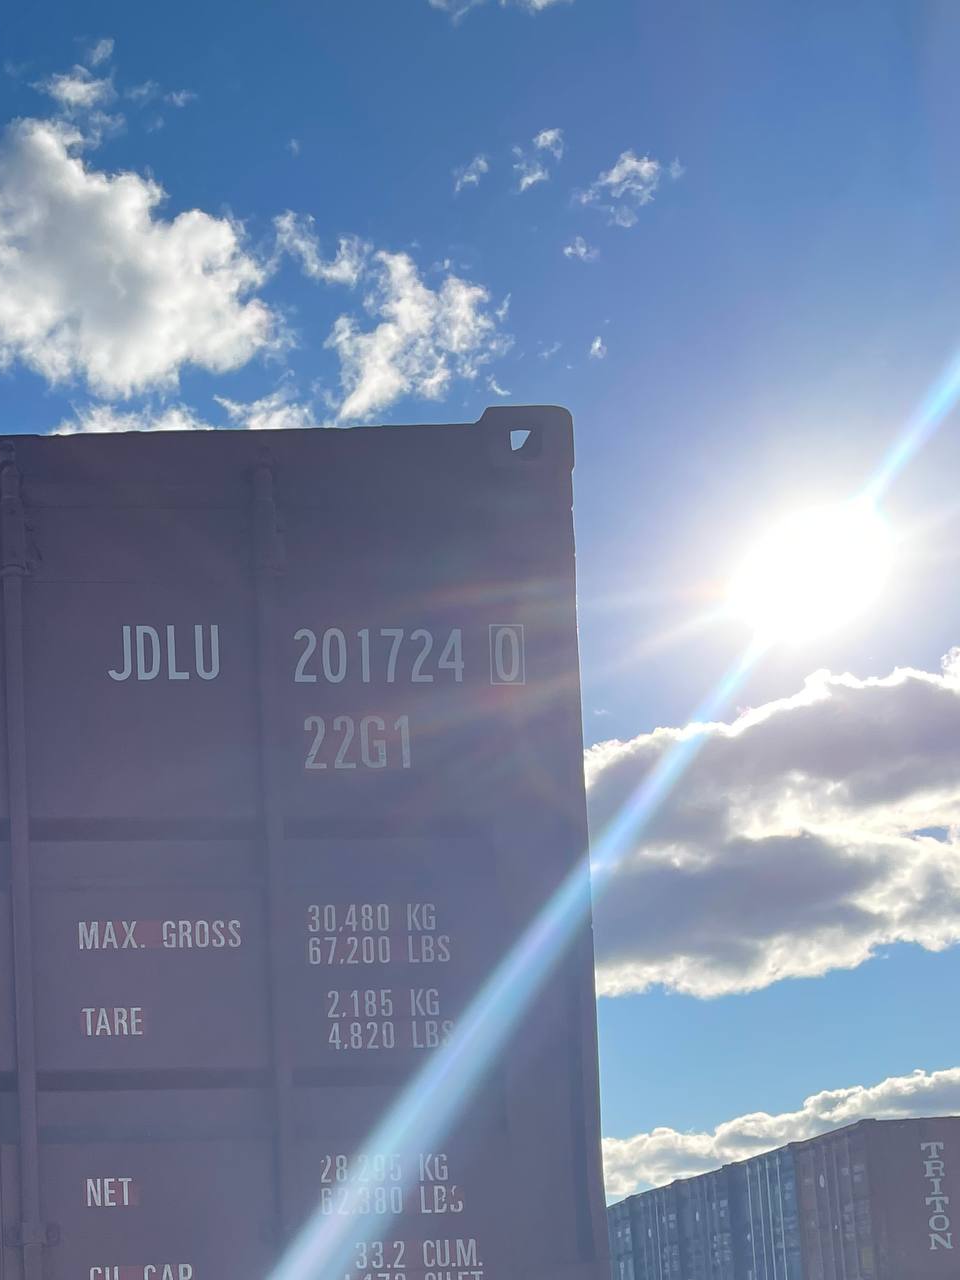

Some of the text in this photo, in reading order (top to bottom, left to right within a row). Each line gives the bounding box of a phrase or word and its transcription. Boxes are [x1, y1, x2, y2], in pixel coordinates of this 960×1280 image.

[108, 624, 522, 684] JDLU 201724 0
[303, 715, 412, 769] 22G1
[406, 903, 437, 931] KG
[78, 919, 242, 950] MAX. GROSS
[408, 935, 451, 963] LBS
[410, 988, 440, 1016] KG
[82, 1007, 143, 1036] TARE
[419, 1153, 449, 1182] KG
[86, 1178, 133, 1207] NET
[420, 1185, 464, 1214] LBS
[920, 1141, 954, 1251] TRITON
[355, 1241, 406, 1270] 33.2
